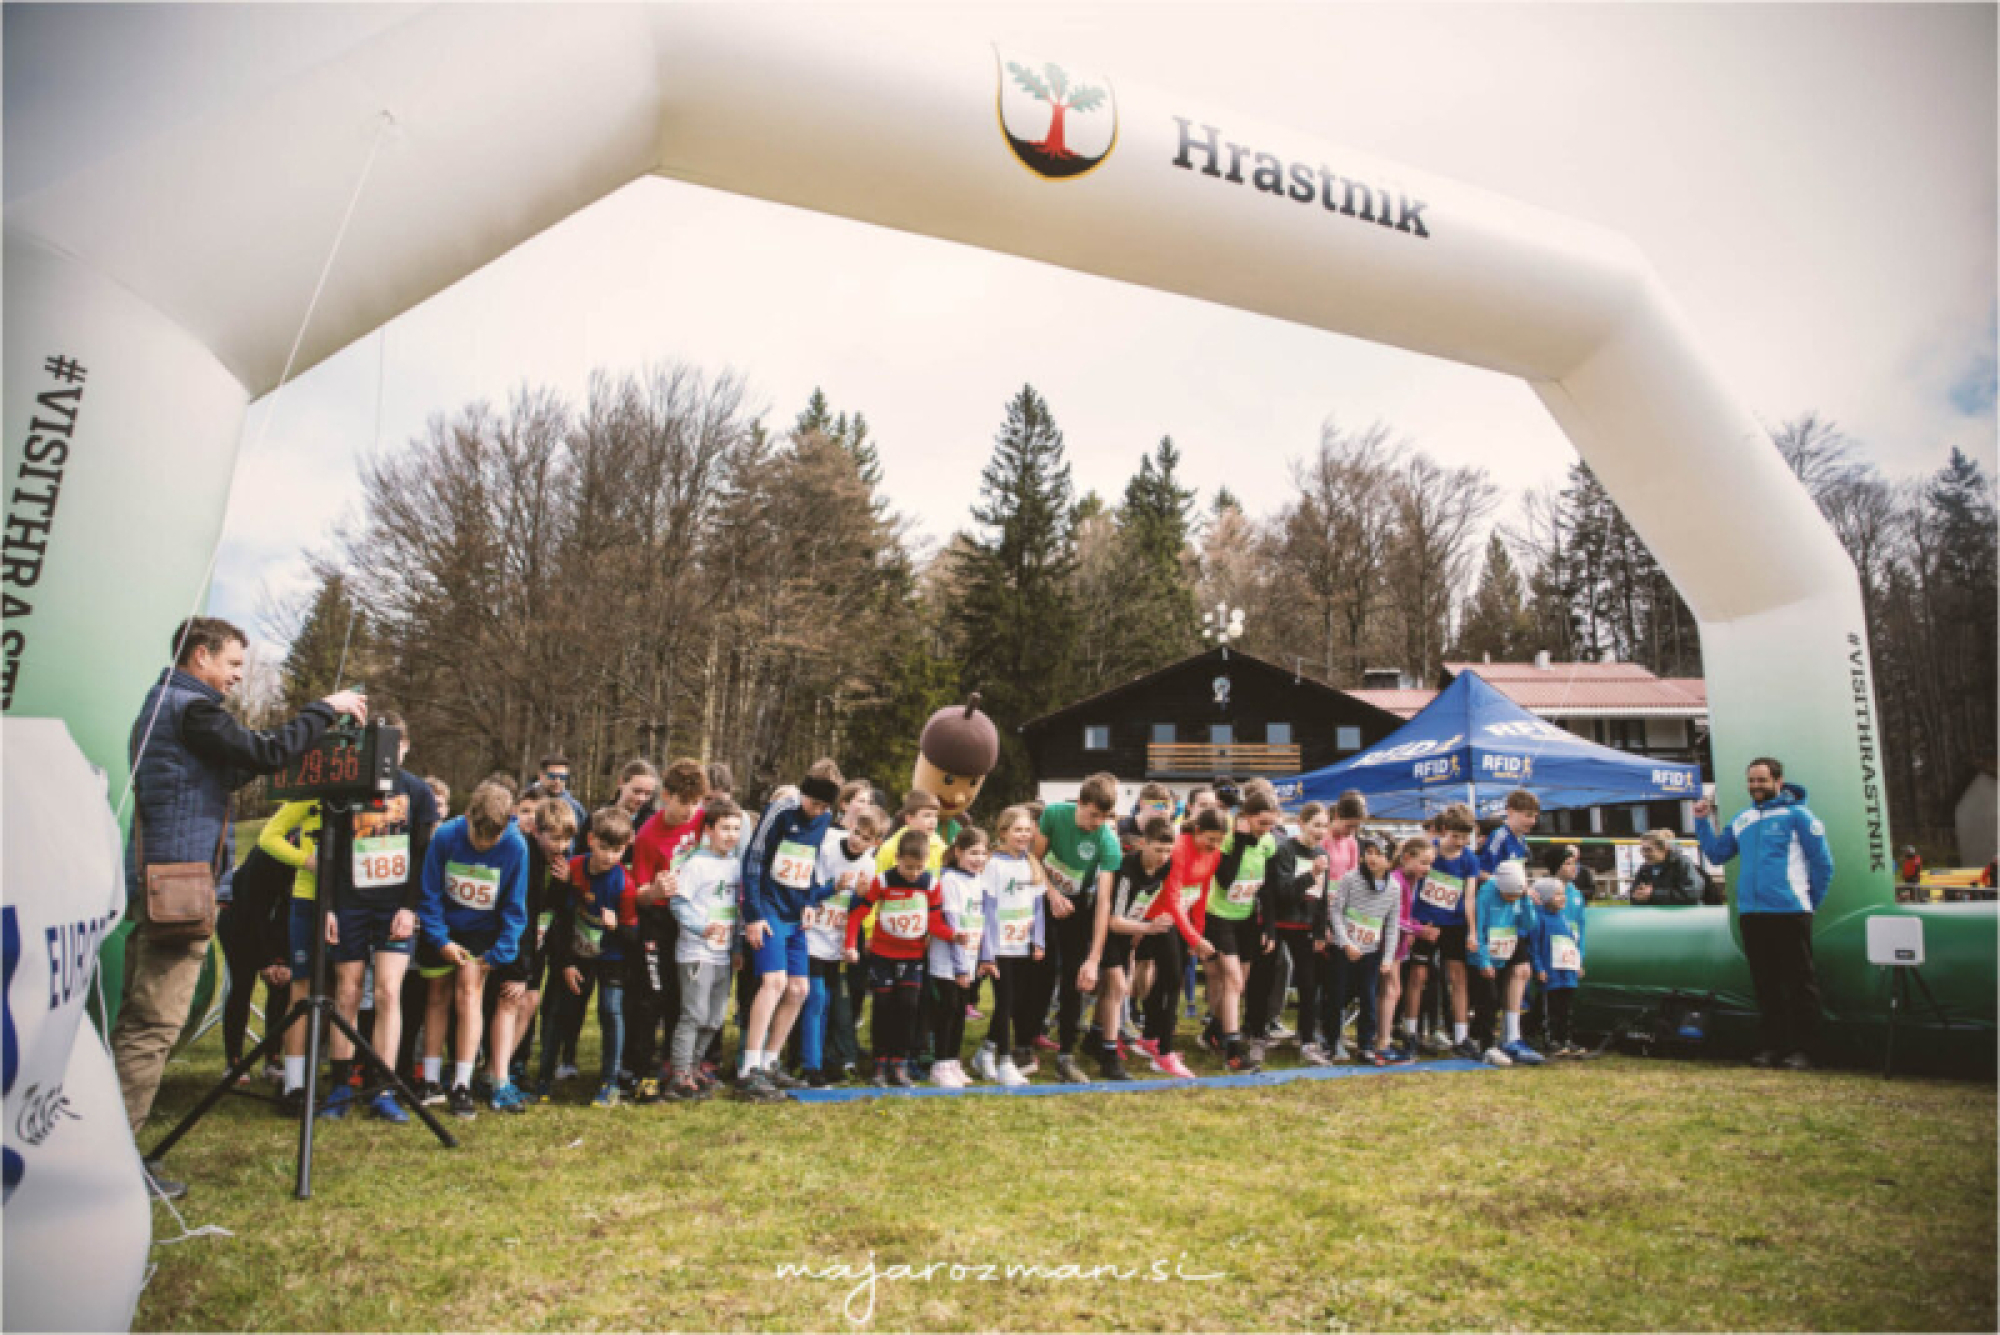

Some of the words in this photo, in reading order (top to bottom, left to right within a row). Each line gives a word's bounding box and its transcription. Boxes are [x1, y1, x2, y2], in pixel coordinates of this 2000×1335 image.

[1172, 115, 1430, 239] Hrastnik
[1482, 754, 1522, 772] RFID
[1847, 632, 1886, 873] #VISITHRASTNIK
[1412, 758, 1450, 778] RFID
[1652, 769, 1685, 786] RFID
[361, 854, 407, 881] 188
[447, 876, 492, 905] 205
[887, 914, 924, 934] 192
